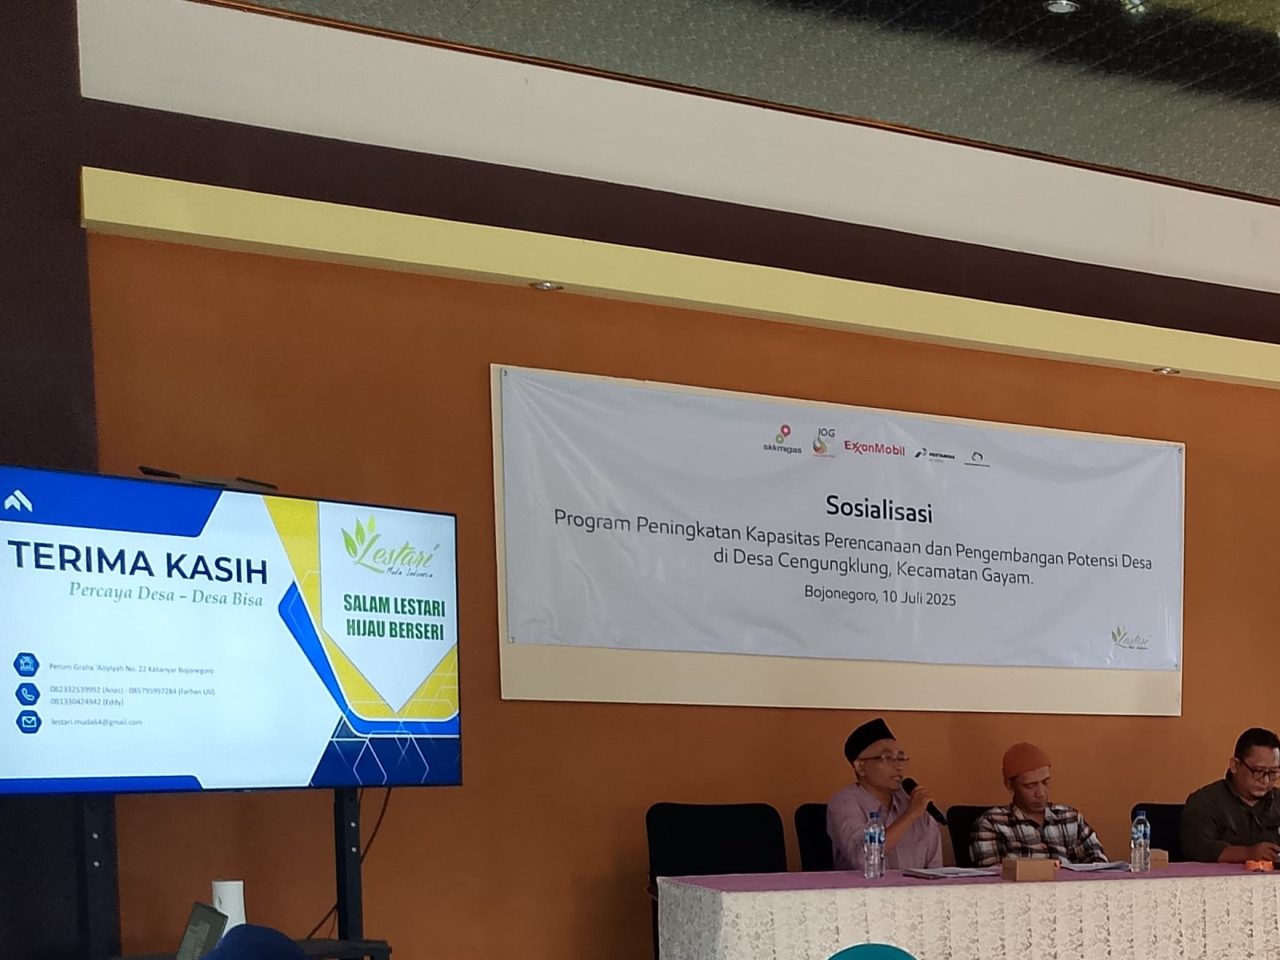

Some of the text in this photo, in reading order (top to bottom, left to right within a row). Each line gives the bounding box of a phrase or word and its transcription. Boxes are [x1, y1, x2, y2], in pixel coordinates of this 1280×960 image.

[763, 444, 802, 455] skkmigas
[844, 440, 906, 456] ExxonMobil
[826, 495, 933, 524] Sosialisasi
[554, 508, 1152, 570] Program Peningkatan Kapasitas Perencanaan dan Pengembangan Potensi Desa
[7, 539, 268, 585] TERIMA KASIH
[354, 533, 440, 574] Lestari
[713, 547, 1034, 588] di Desa Cengungklung, Kecamatan Gayam.
[69, 581, 132, 602] Percaya
[137, 585, 175, 602] Desa
[191, 589, 228, 605] Desa
[232, 591, 264, 607] Bisa
[343, 593, 446, 617] SALAM LESTARI
[804, 584, 957, 606] Bojonegoro, 10 Juli 2025
[346, 618, 444, 641] HIJAU BERSERI
